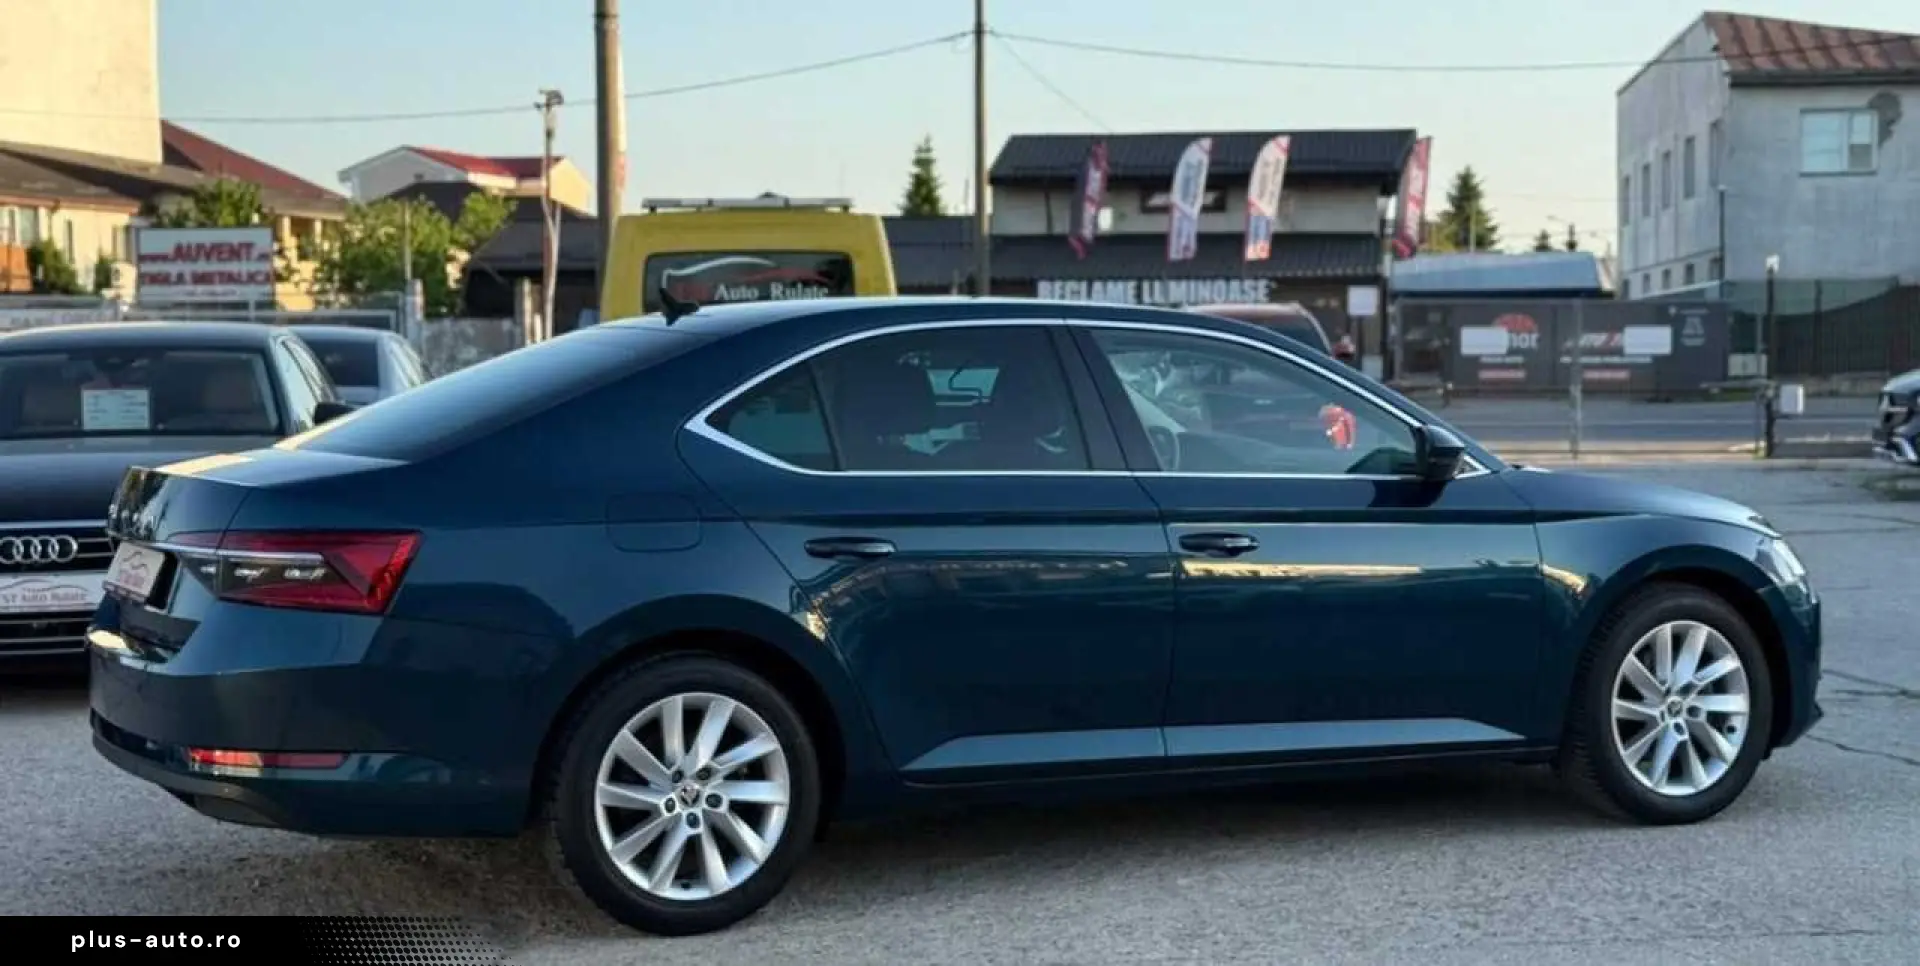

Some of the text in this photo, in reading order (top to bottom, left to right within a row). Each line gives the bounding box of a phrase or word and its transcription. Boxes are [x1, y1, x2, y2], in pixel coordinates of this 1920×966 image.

[714, 283, 759, 300] Auto
[770, 282, 828, 300] Rulate
[1038, 279, 1137, 301] RECLAME
